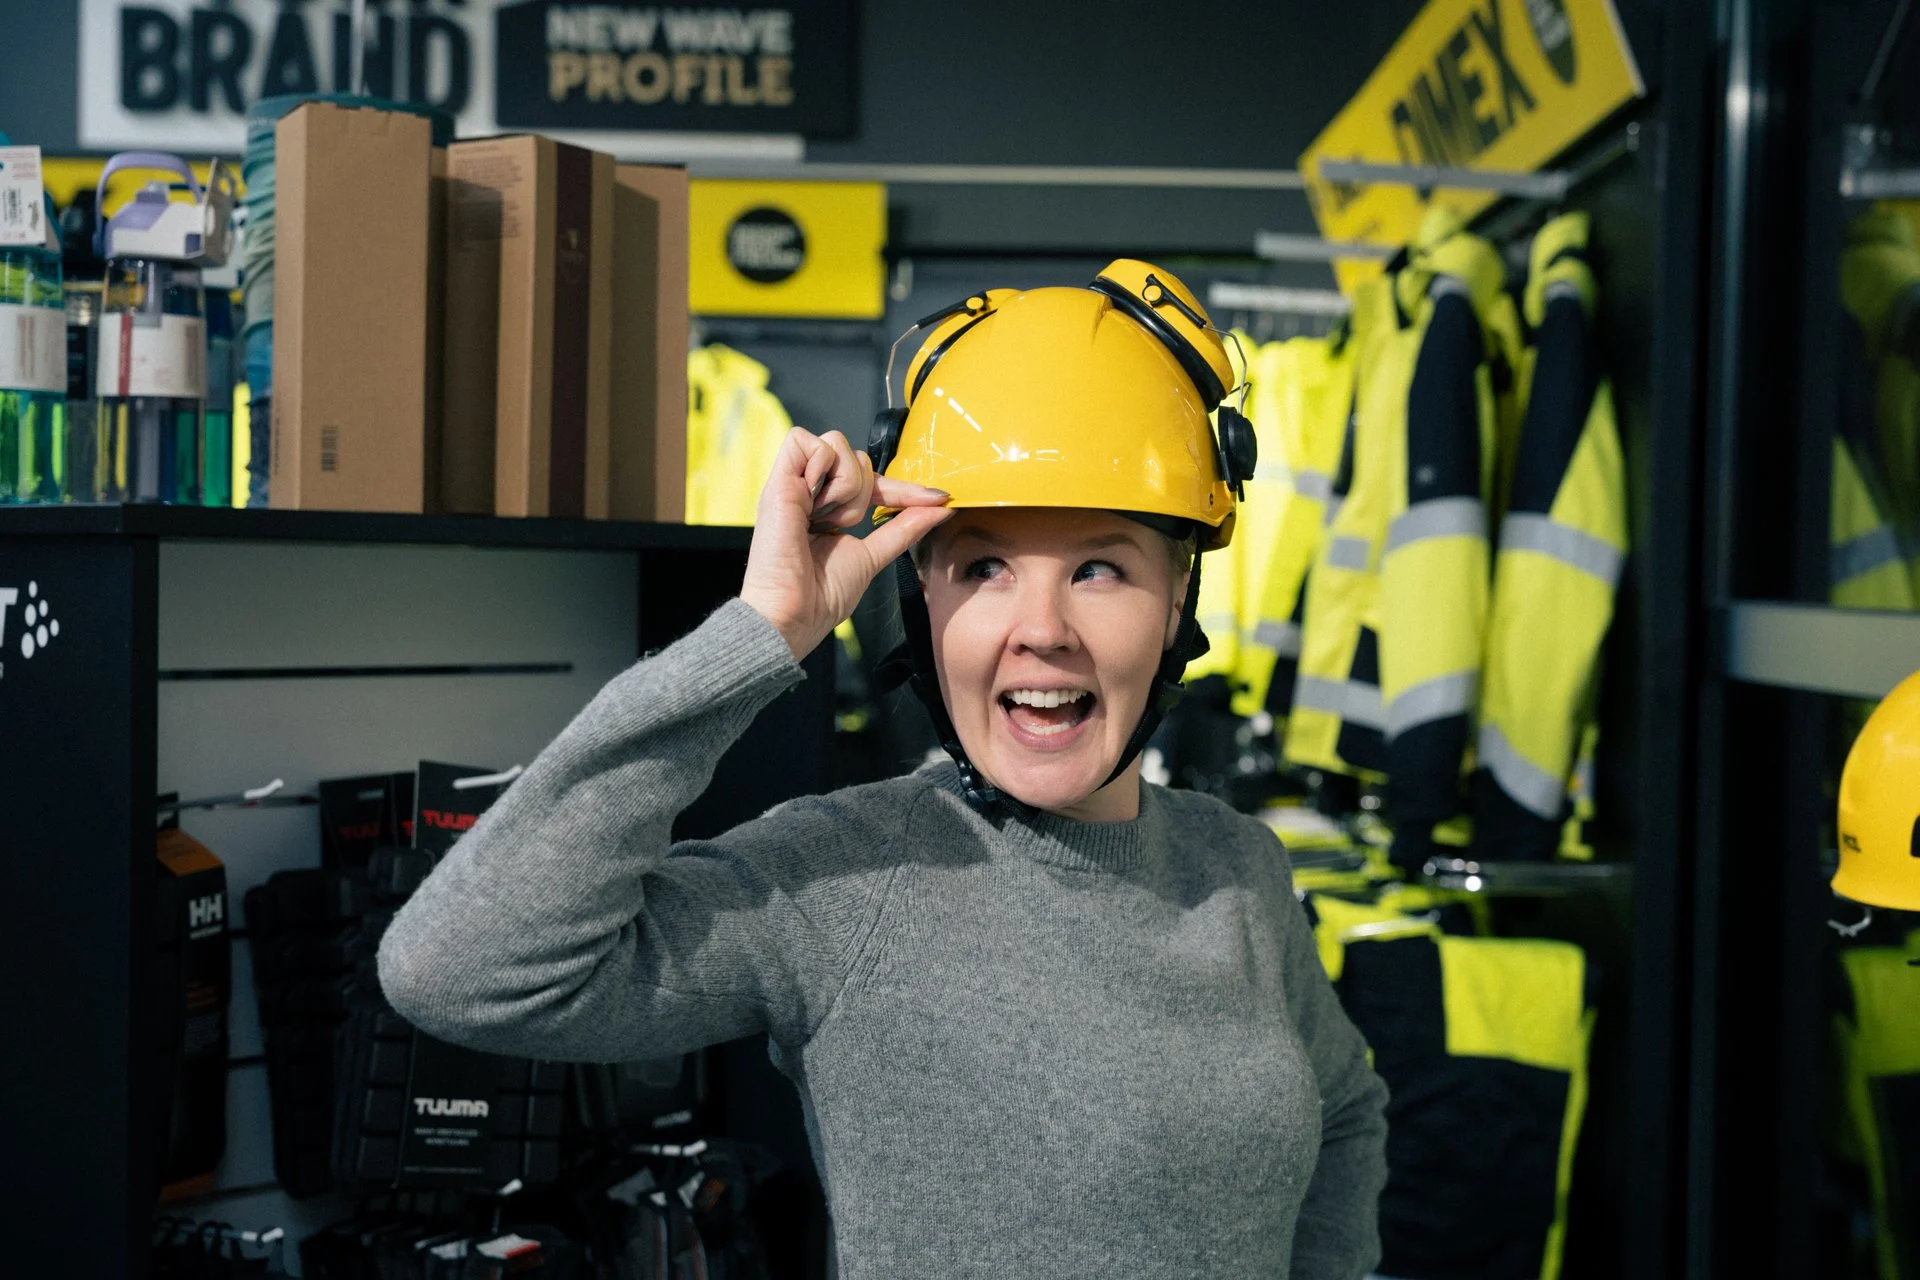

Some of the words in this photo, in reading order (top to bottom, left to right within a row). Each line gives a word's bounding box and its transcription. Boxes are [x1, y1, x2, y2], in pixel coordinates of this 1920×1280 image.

[547, 7, 657, 50] NEW
[661, 9, 793, 53] WAVE
[120, 7, 471, 116] BRAND
[548, 52, 793, 105] PROFILE
[189, 894, 222, 927] HH
[414, 1098, 490, 1118] TUUMA
